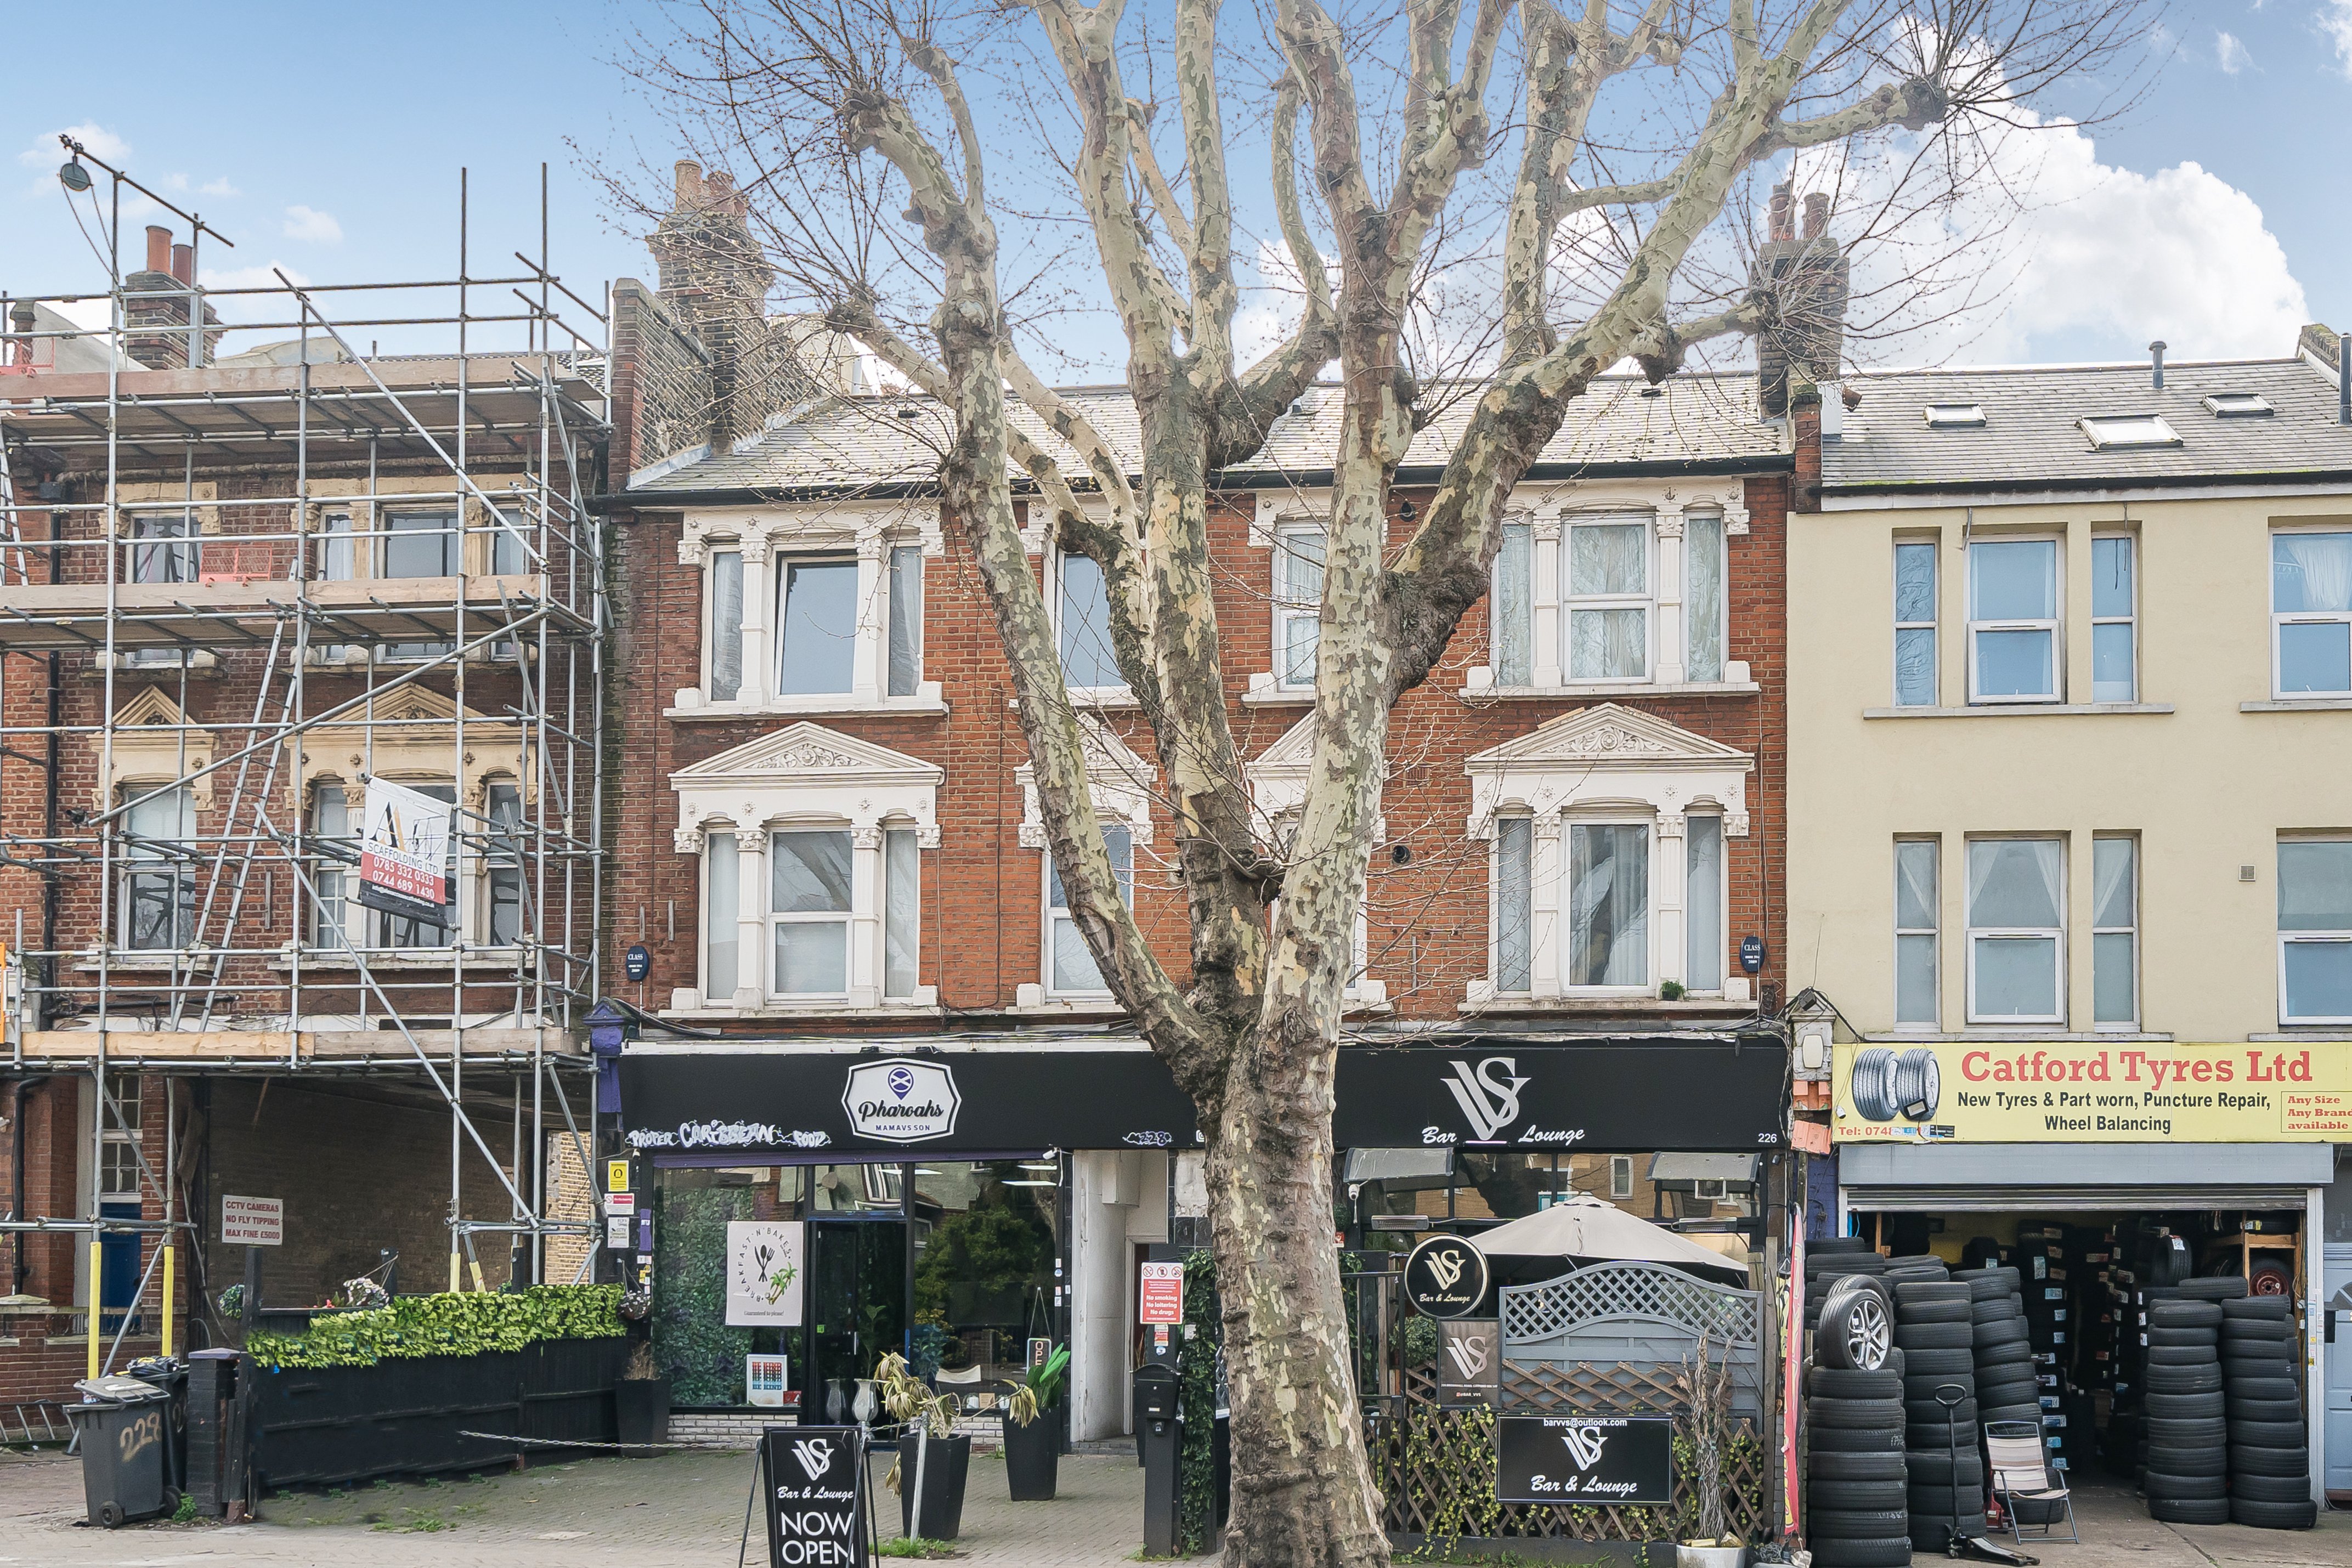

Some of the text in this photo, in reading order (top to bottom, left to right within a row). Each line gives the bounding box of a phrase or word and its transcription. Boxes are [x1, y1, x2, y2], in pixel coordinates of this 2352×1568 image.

[368, 842, 439, 875] SCAFFOLDING LTD
[374, 856, 434, 886] 0785 332 0333
[372, 870, 394, 886] 0744
[397, 879, 413, 892] 689
[416, 884, 435, 899] 1430
[1961, 1051, 2313, 1090] Catford Tyres Ltd
[1958, 1092, 2270, 1111] New Tyres & Part worn, Puncture Repair,
[2287, 1096, 2311, 1106] Any
[858, 1100, 944, 1122] Pharoahs
[2287, 1108, 2311, 1118] Any
[1839, 1127, 1861, 1136] Tel:
[2045, 1116, 2171, 1134] Wheel Balancing
[630, 1129, 672, 1147] PROPER
[792, 1130, 826, 1147] FOOD
[1139, 1131, 1167, 1146] 228
[1421, 1124, 1585, 1146] Bar Lounge
[1758, 1133, 1777, 1143] 226
[226, 1201, 279, 1212] CCTV CAMERAS
[252, 1217, 279, 1226] TIPPING
[261, 1231, 280, 1239] £5000
[738, 1236, 761, 1303] BREAKFAST
[767, 1227, 792, 1254] BAKES
[1420, 1293, 1471, 1304] Bar & Lounge
[1035, 1341, 1044, 1366] OPE
[1544, 1418, 1627, 1428] barvvs@outlook.com
[120, 1412, 162, 1463] 228
[777, 1486, 854, 1502] Bar & Lounge
[1530, 1475, 1637, 1497] Bar & Lounge
[781, 1512, 854, 1536] NOW
[782, 1540, 855, 1564] OPEN
